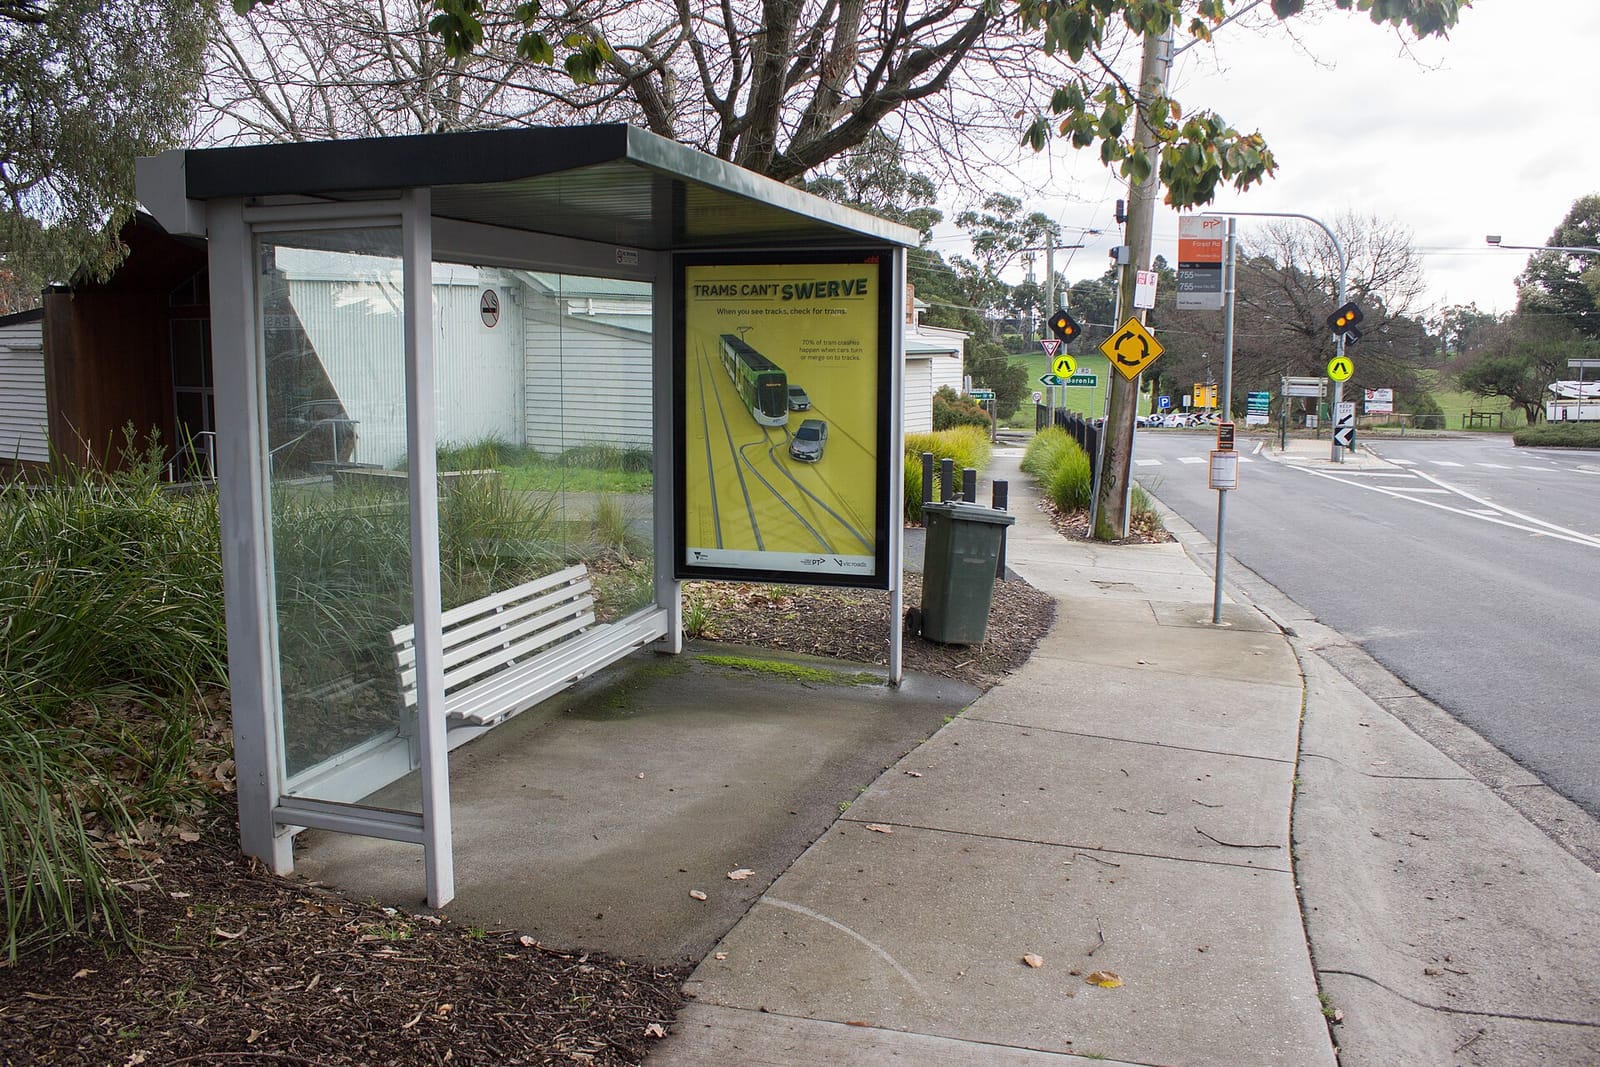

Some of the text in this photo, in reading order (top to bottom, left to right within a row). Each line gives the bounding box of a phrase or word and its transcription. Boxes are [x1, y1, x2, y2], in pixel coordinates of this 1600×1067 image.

[693, 279, 868, 300] TRAMS CAN'T SWERVE
[1161, 398, 1168, 407] P
